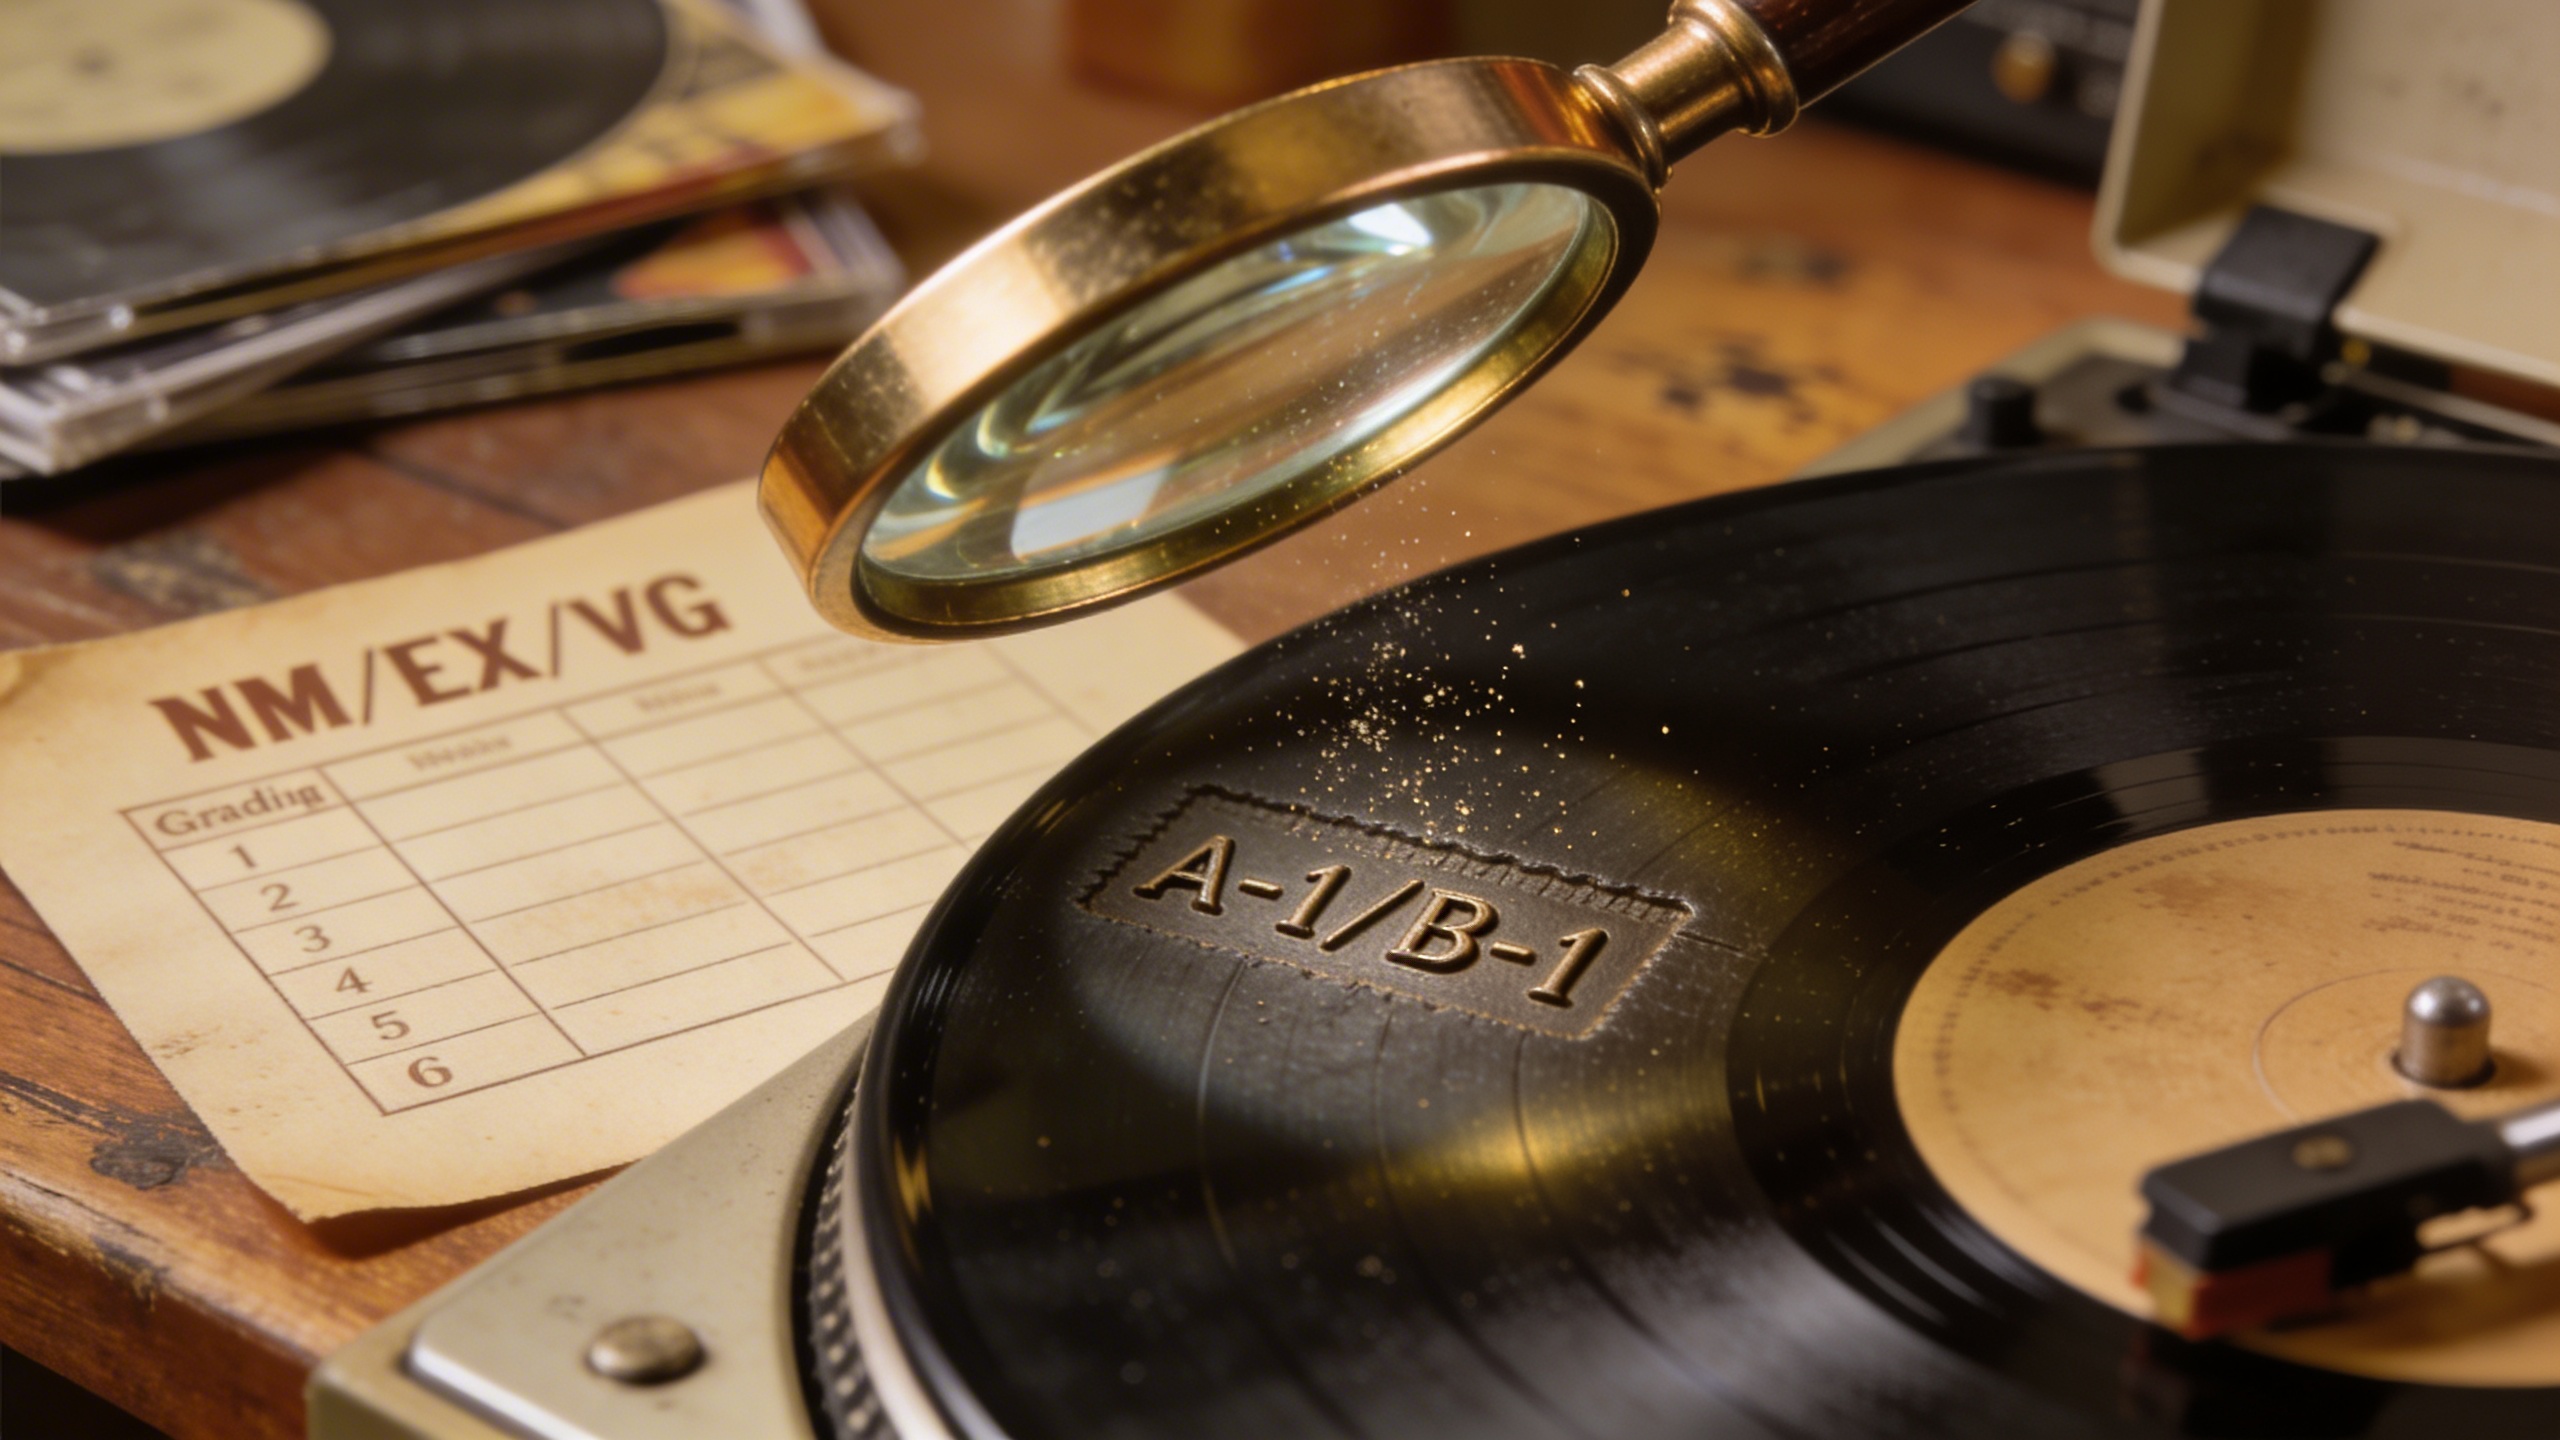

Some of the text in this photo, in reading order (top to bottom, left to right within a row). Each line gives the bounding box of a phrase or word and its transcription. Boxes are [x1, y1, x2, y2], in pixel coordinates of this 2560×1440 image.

[148, 571, 732, 762] NM/EX/VG
[154, 782, 325, 837] Grading
[229, 844, 258, 869] 1
[260, 882, 299, 912] 2
[1132, 835, 1609, 1008] A-1/B-1
[294, 924, 332, 953] 3
[335, 967, 372, 995] 4
[370, 1010, 411, 1041] 5
[407, 1055, 454, 1089] 6
